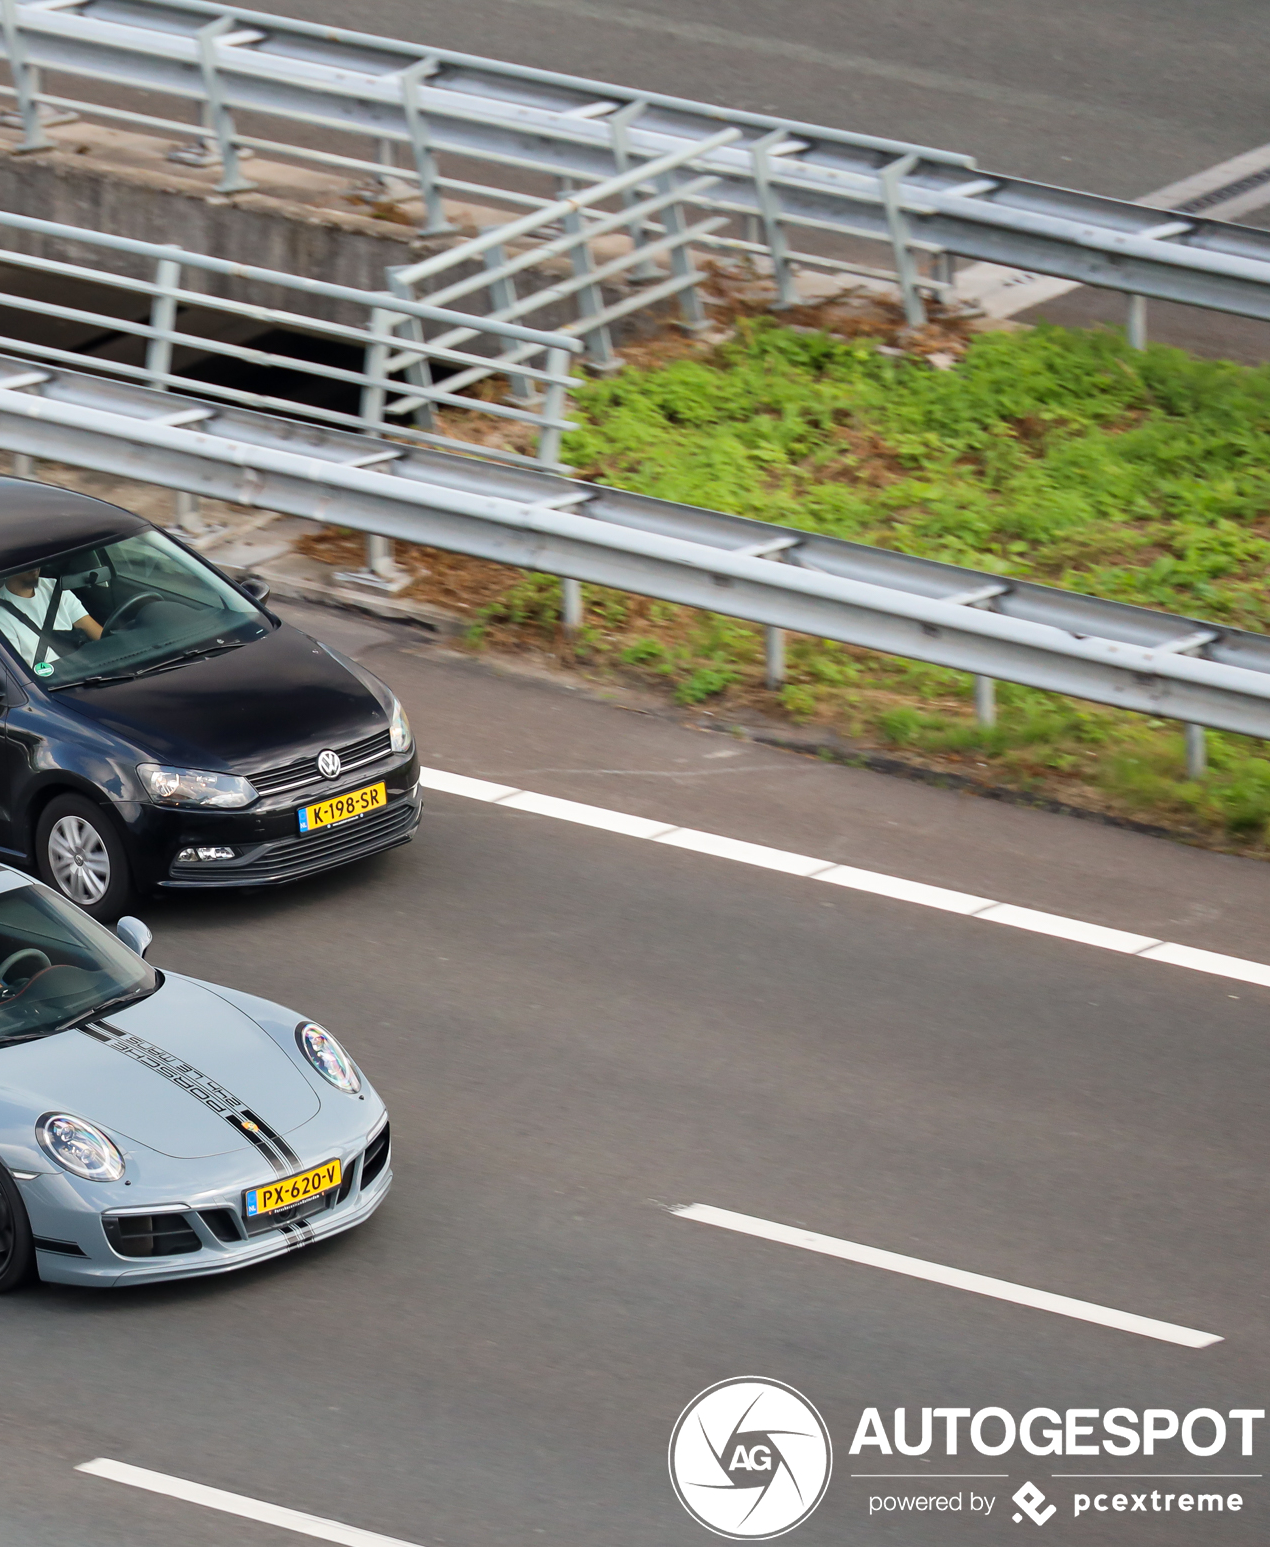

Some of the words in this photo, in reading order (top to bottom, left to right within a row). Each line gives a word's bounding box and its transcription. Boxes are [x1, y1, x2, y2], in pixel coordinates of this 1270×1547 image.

[313, 788, 380, 825] K-198-SR
[110, 1041, 227, 1113] PORSCHE
[176, 1063, 204, 1080] LE
[248, 1204, 257, 1212] NL
[262, 1165, 335, 1208] PX-620-V
